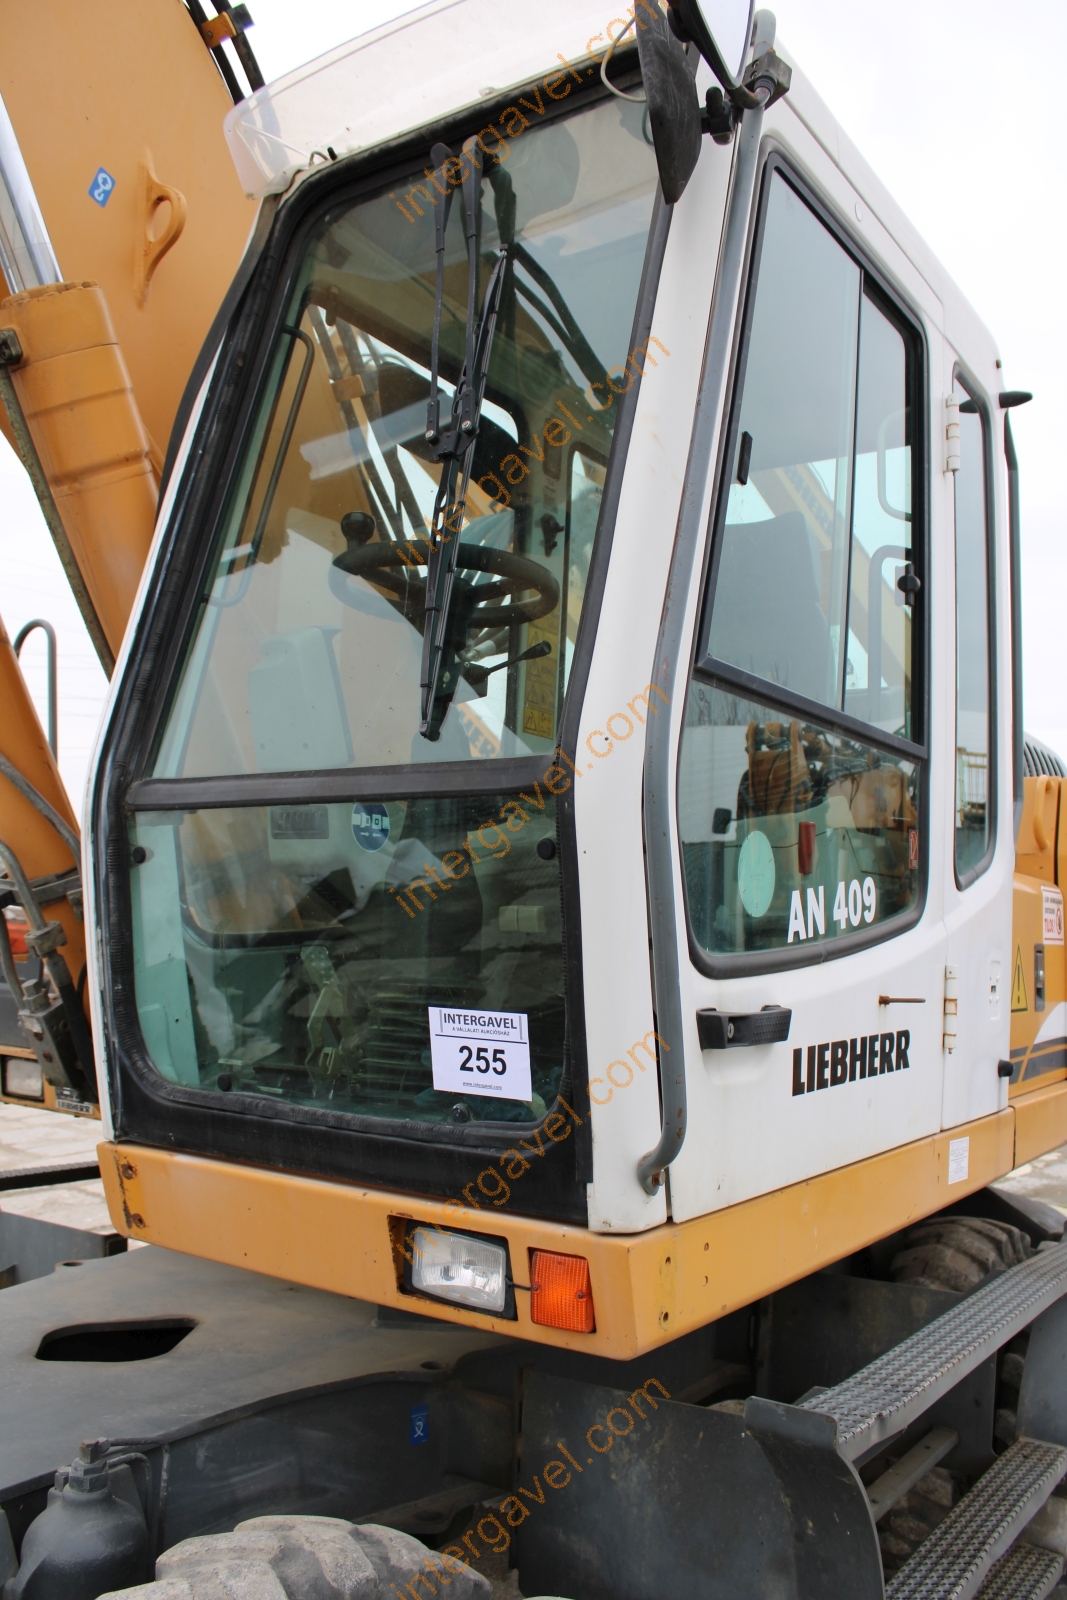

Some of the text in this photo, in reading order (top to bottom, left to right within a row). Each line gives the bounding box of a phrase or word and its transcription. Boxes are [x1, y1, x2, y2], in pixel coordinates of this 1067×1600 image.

[787, 876, 876, 943] AN 409
[443, 1013, 517, 1029] INTERGAVEL
[459, 1045, 507, 1075] 255
[792, 1029, 910, 1096] LIEBHERR
